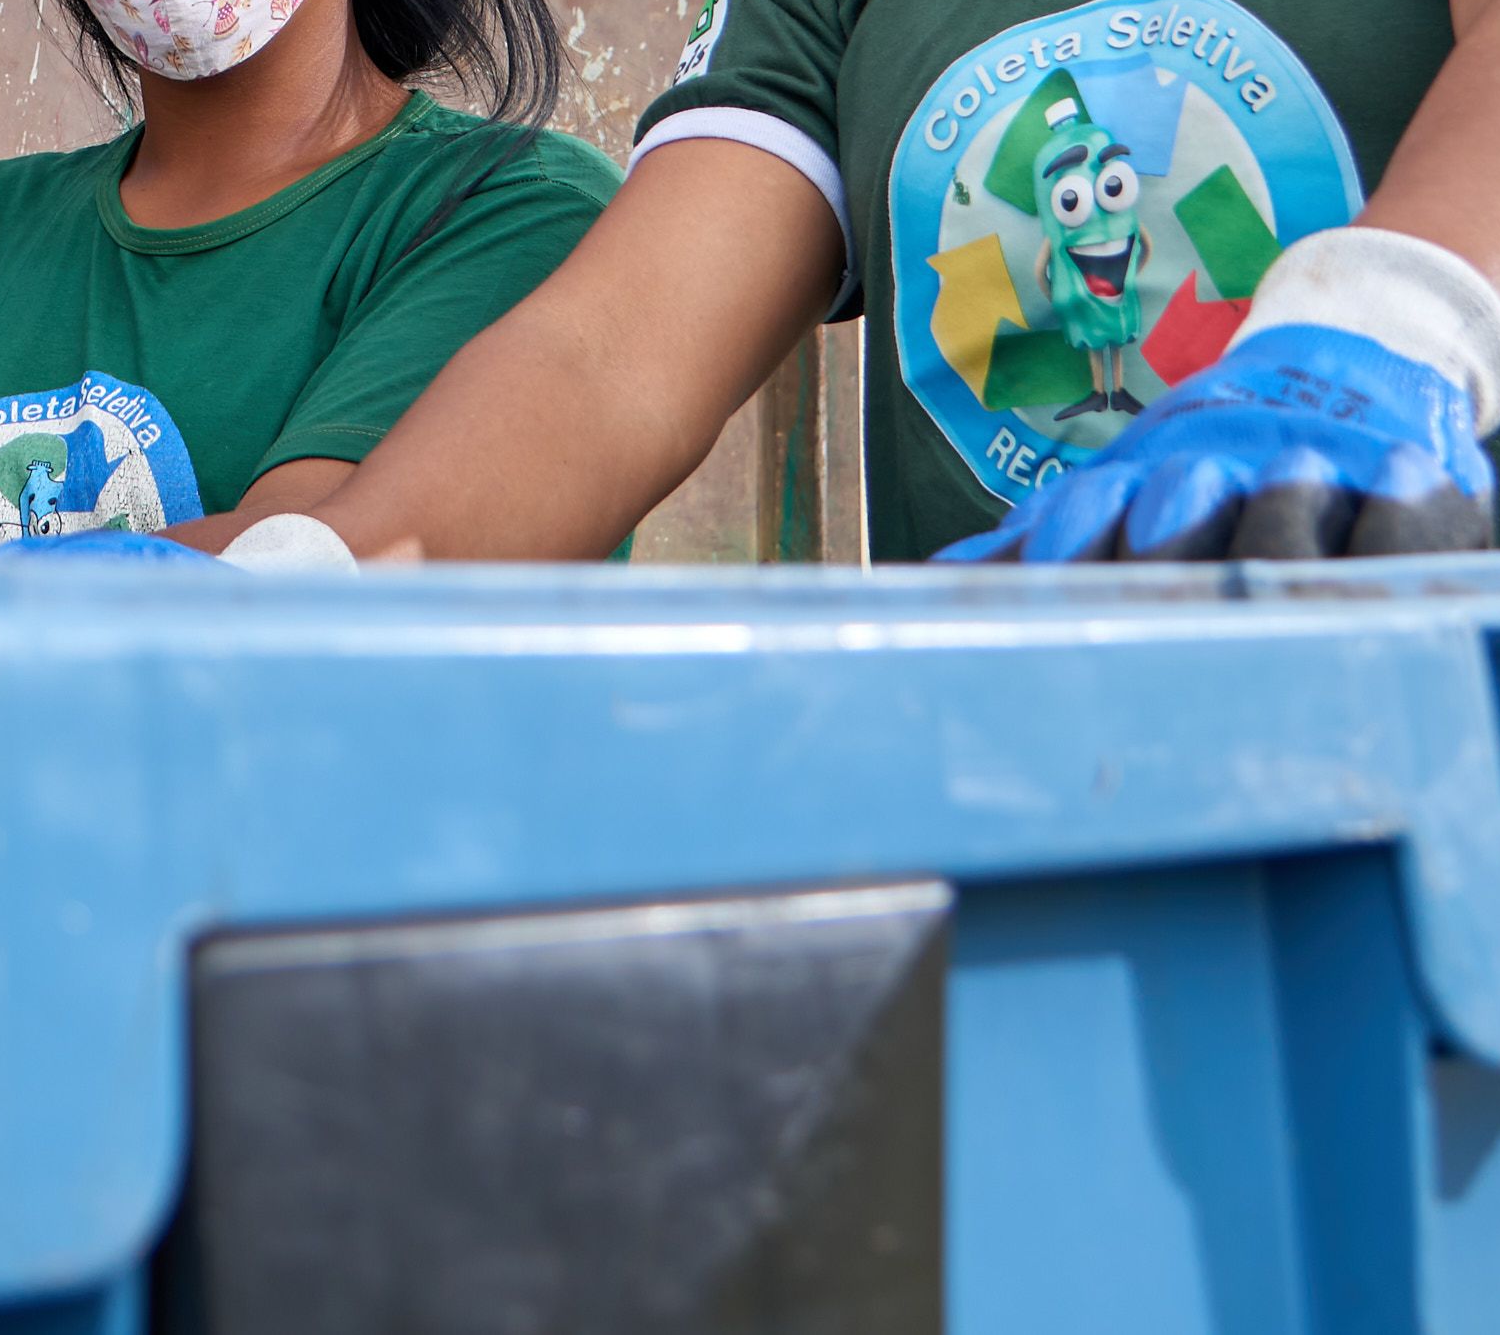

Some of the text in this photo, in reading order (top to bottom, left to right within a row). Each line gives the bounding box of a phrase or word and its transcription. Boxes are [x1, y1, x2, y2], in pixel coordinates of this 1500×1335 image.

[923, 3, 1278, 154] Coleta Seletiva
[80, 377, 162, 449] Seletiva
